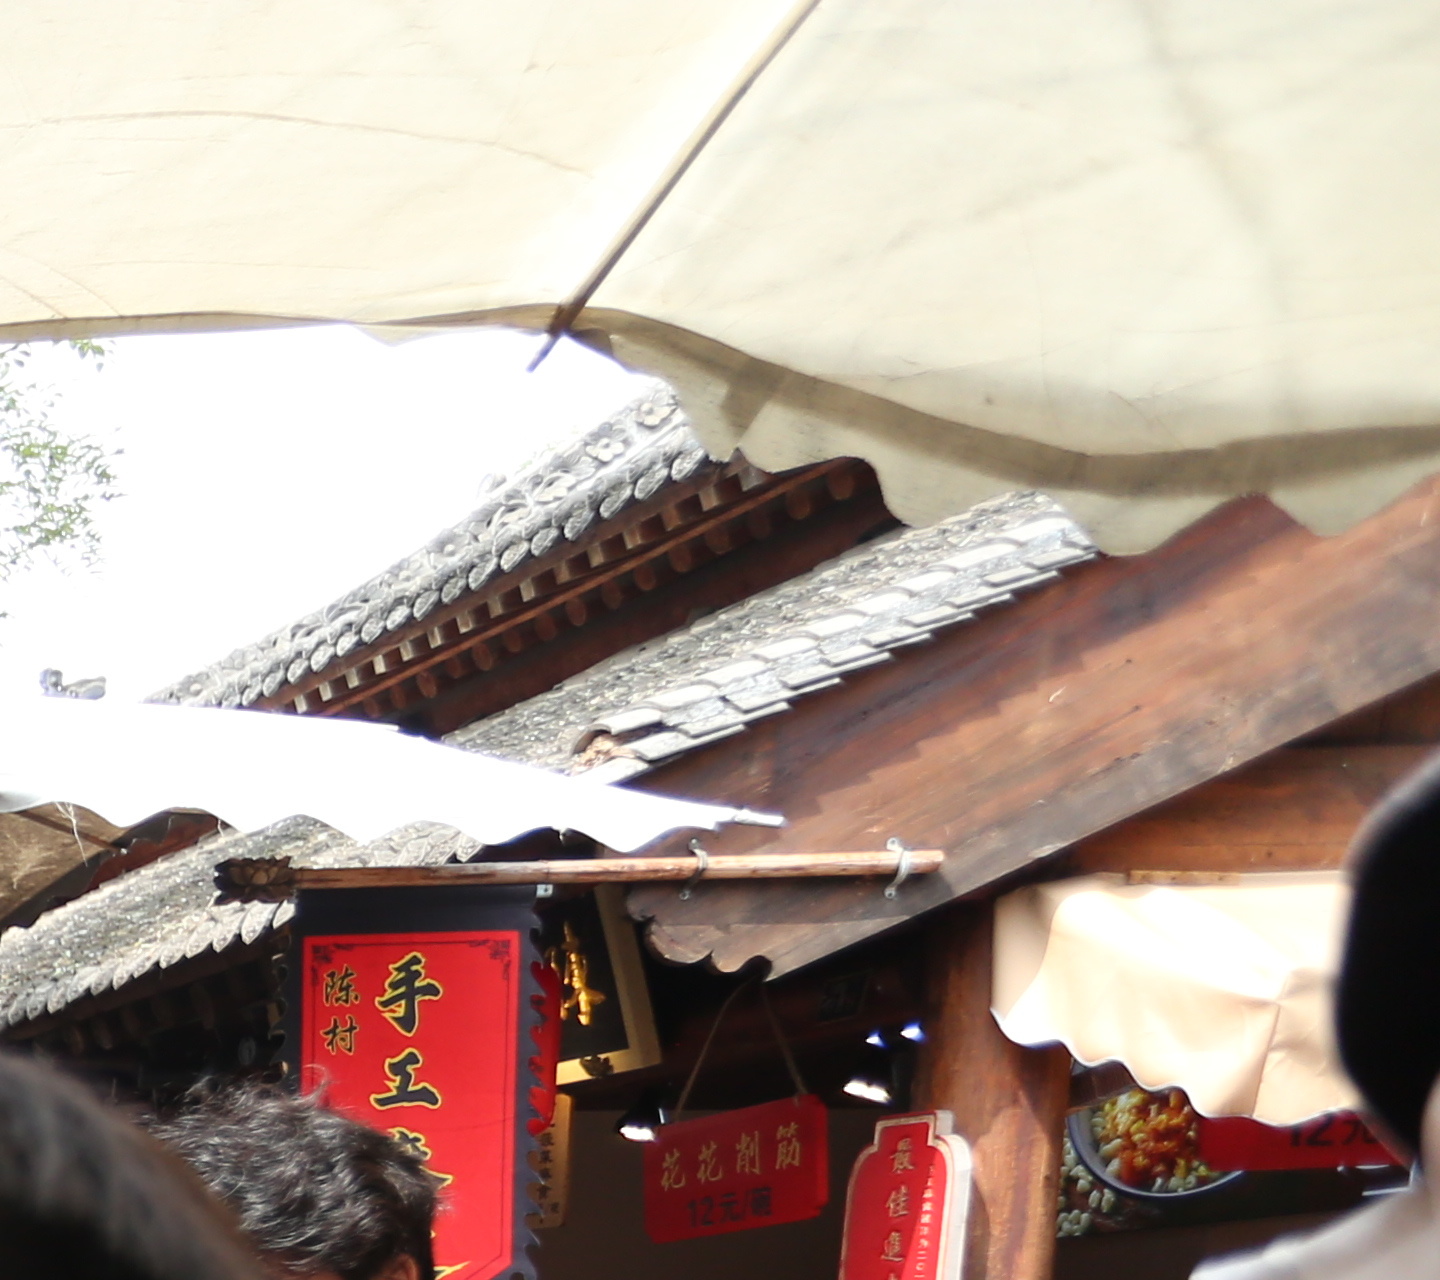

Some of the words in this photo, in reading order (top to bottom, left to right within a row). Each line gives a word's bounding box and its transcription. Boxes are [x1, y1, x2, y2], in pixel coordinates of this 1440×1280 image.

[321, 964, 361, 1056] 陈村
[660, 1122, 802, 1192] 花花削筋
